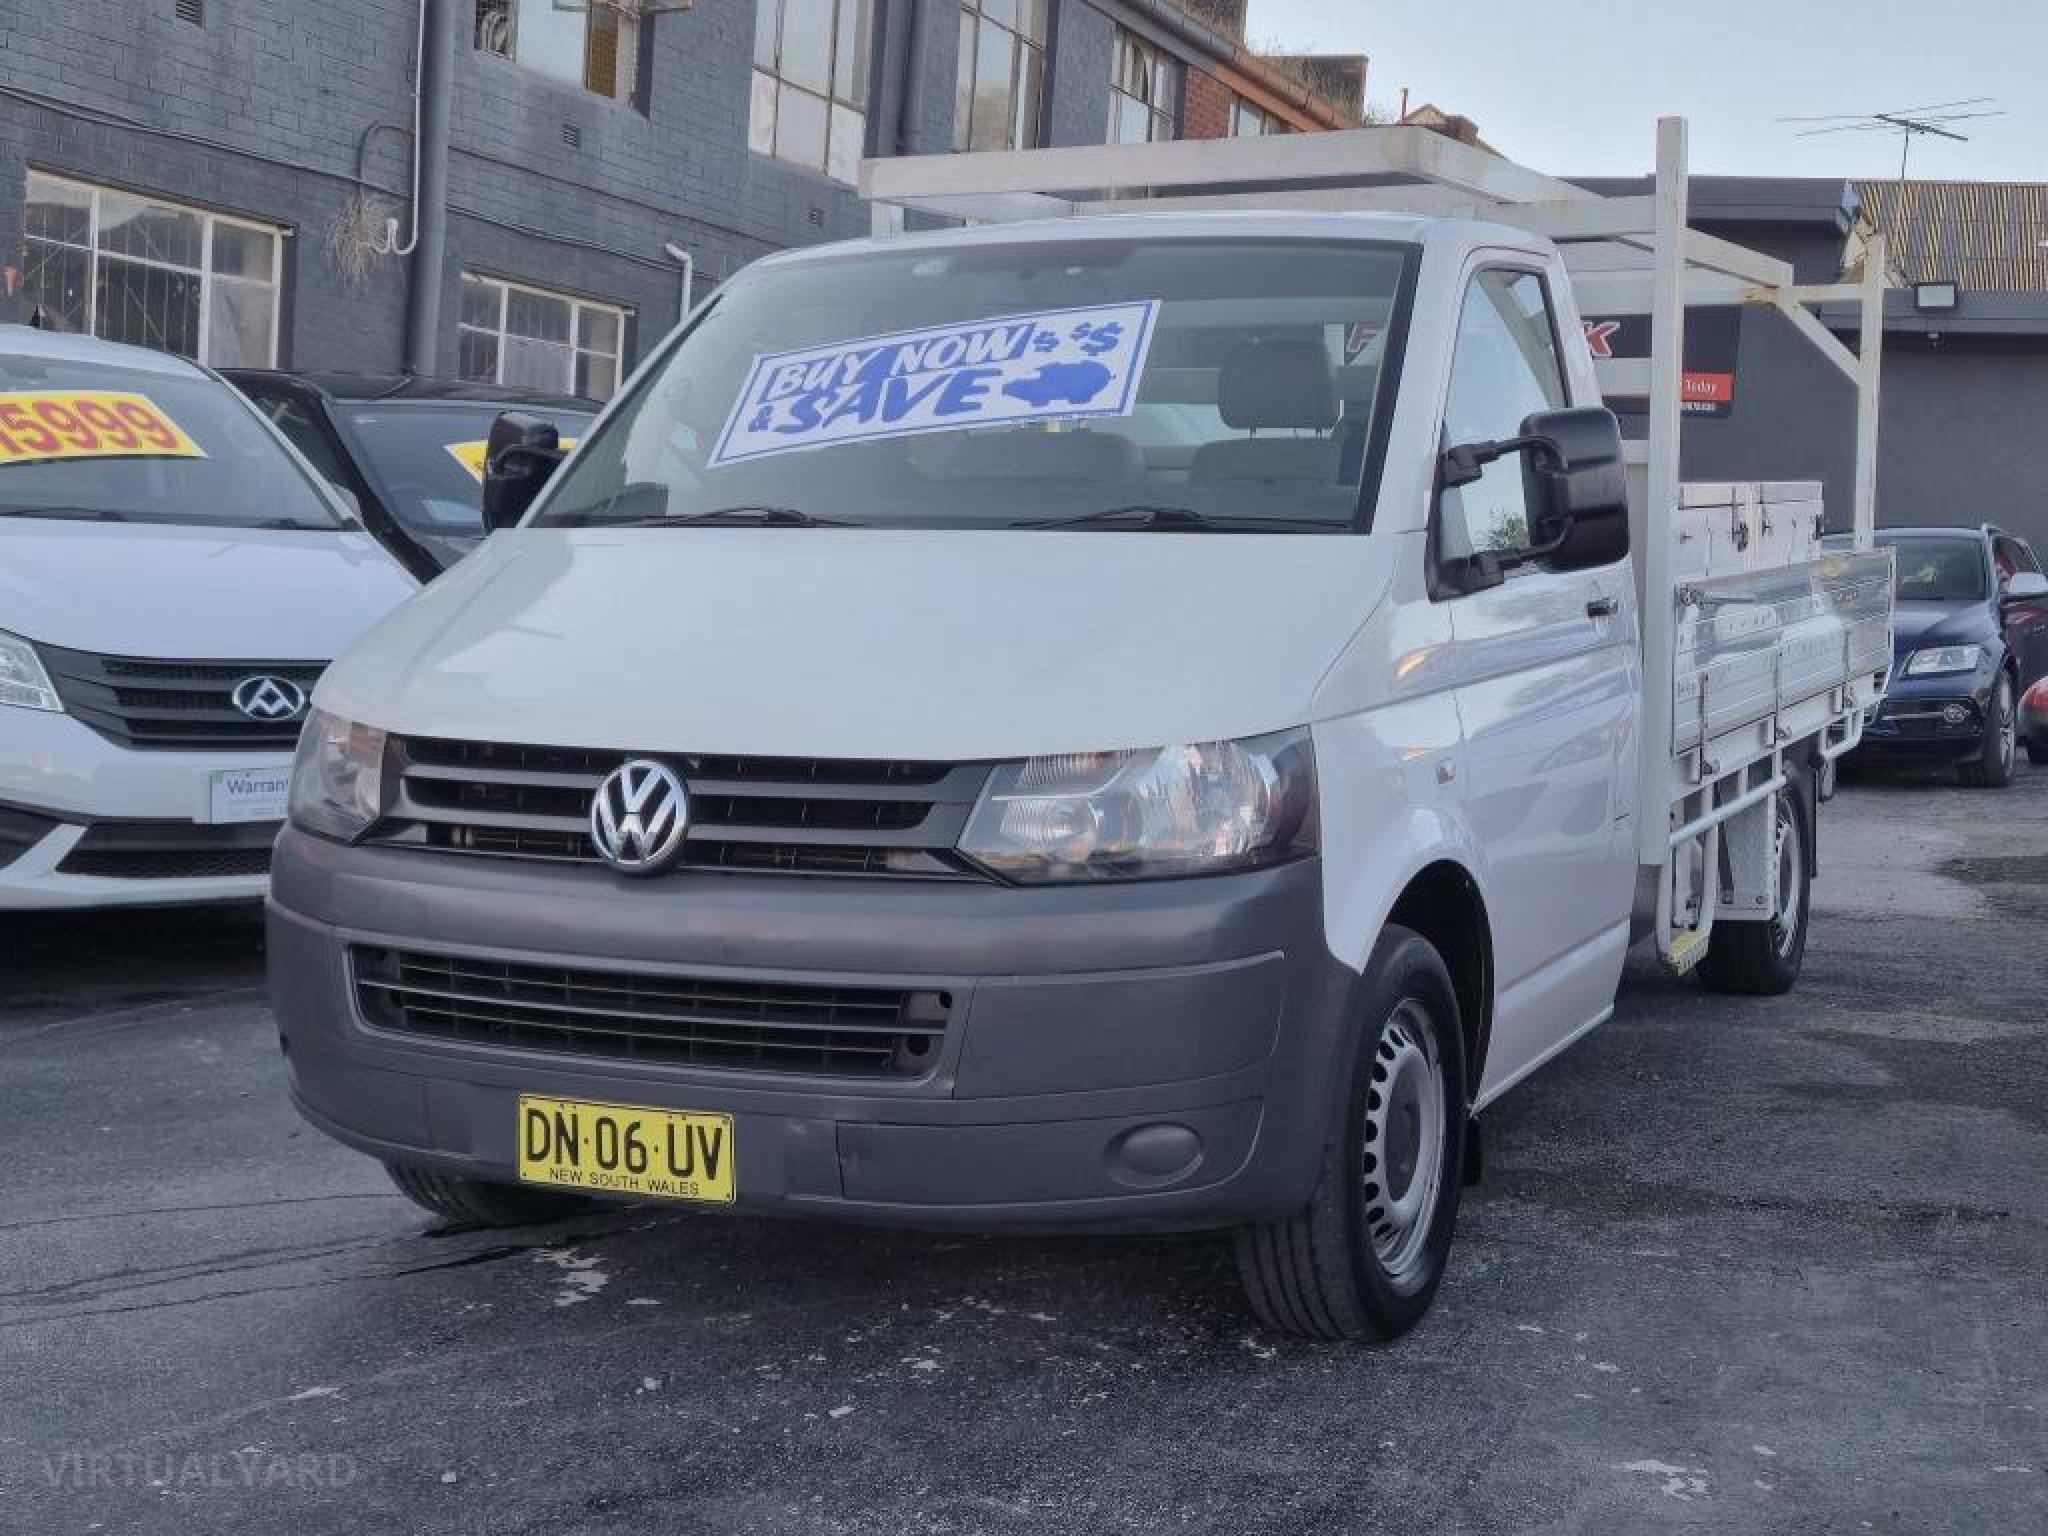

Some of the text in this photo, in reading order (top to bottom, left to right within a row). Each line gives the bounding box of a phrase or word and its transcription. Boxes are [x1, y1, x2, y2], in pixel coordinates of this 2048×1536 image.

[768, 346, 884, 397] BUY
[890, 325, 1030, 374] NOW
[774, 368, 1003, 435] SAVE
[1685, 379, 1717, 396] Today
[226, 778, 288, 793] Warran
[550, 1167, 700, 1197] NEW SOUTH WALES
